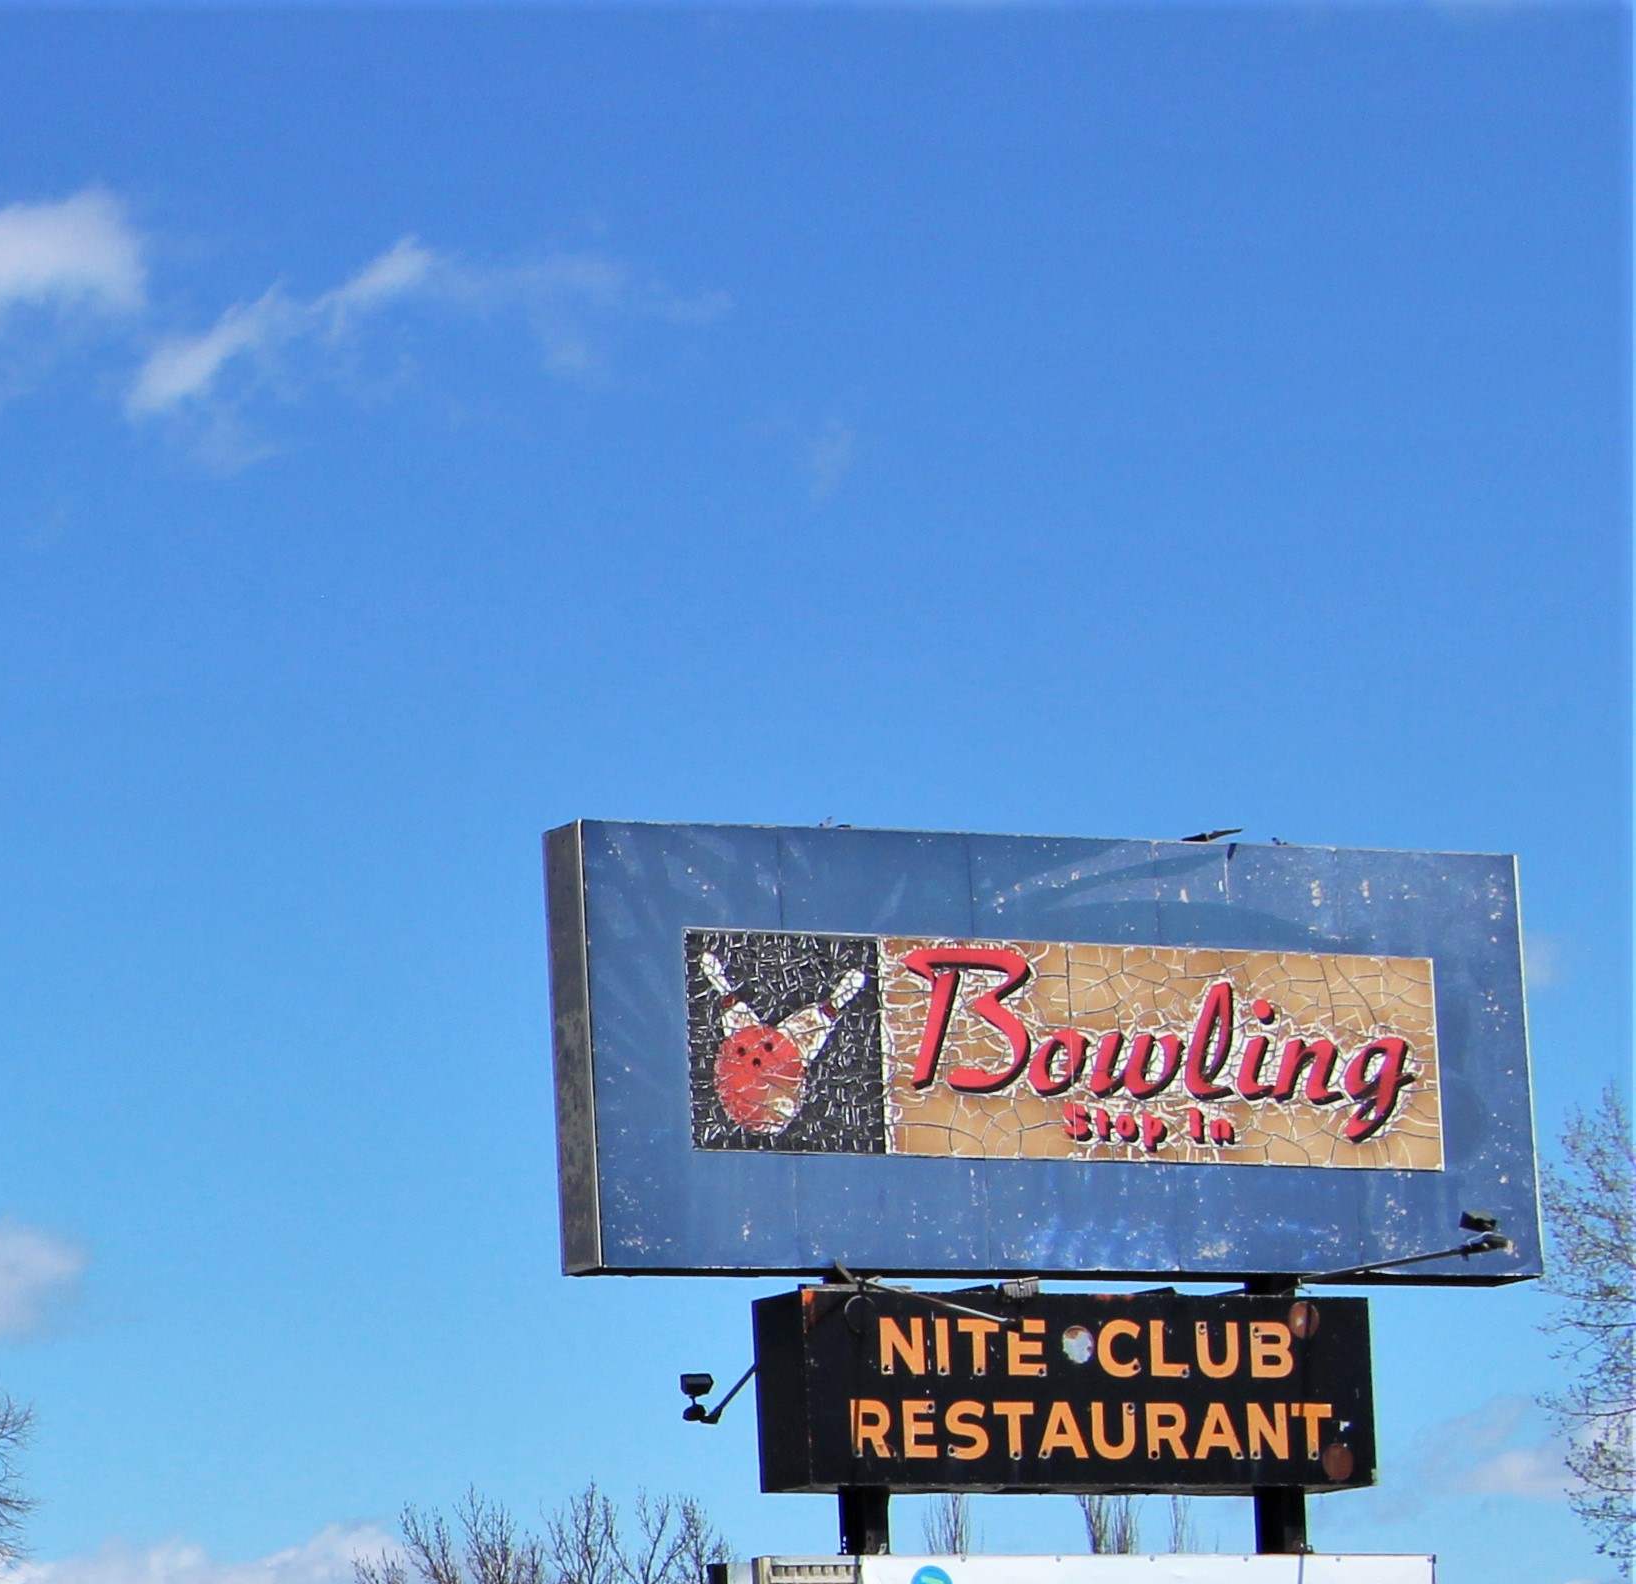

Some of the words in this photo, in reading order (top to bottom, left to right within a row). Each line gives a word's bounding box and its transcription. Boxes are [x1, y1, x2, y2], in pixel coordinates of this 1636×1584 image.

[901, 946, 1417, 1145] Bowling
[1062, 1102, 1169, 1153] Stop
[1186, 1106, 1235, 1146] In
[878, 1316, 1047, 1377] NITE
[1097, 1318, 1295, 1380] CLUB
[849, 1398, 1333, 1461] RESTAURANT
